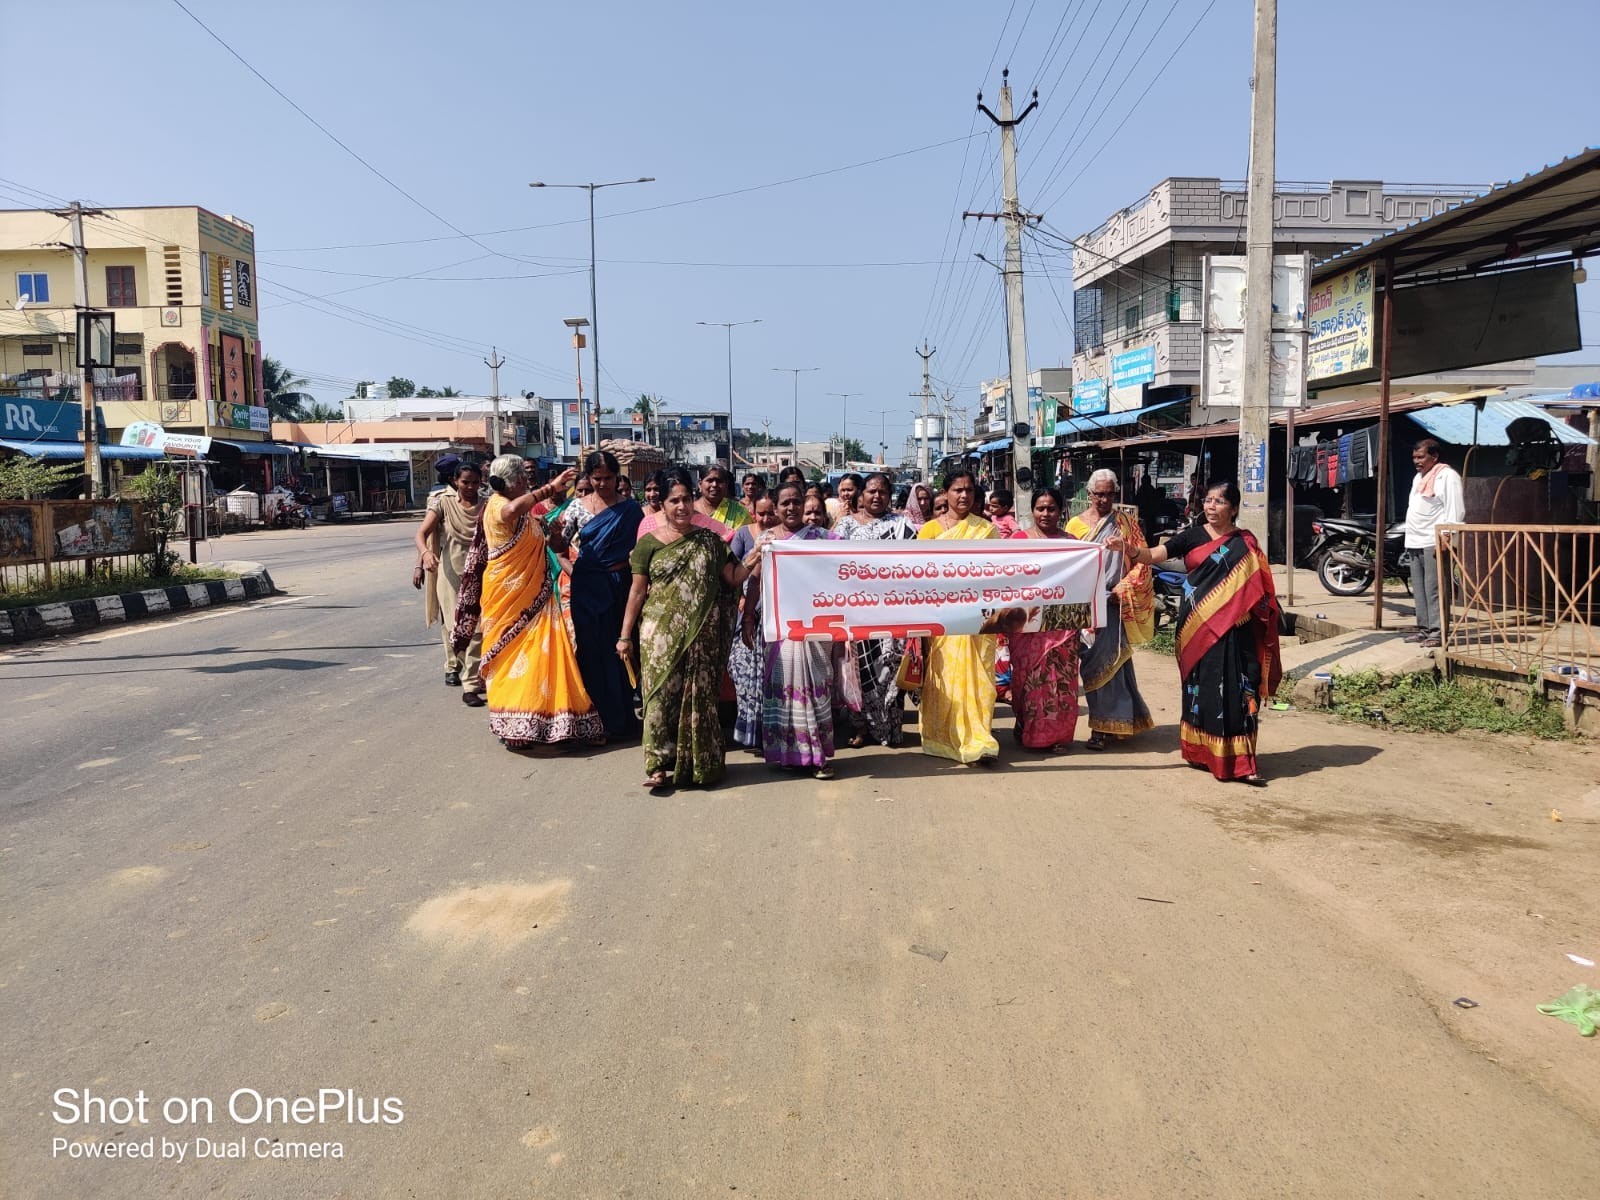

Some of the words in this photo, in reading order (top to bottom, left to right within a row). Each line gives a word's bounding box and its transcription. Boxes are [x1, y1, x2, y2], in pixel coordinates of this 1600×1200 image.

[5, 403, 43, 432] RR
[233, 408, 249, 420] Sprite
[162, 441, 203, 450] FAVOURITE
[838, 560, 939, 581] కోతులనుండి
[812, 590, 880, 608] మరియు
[883, 588, 979, 608] మనుషులను
[982, 585, 1066, 603] కాపాడాలని
